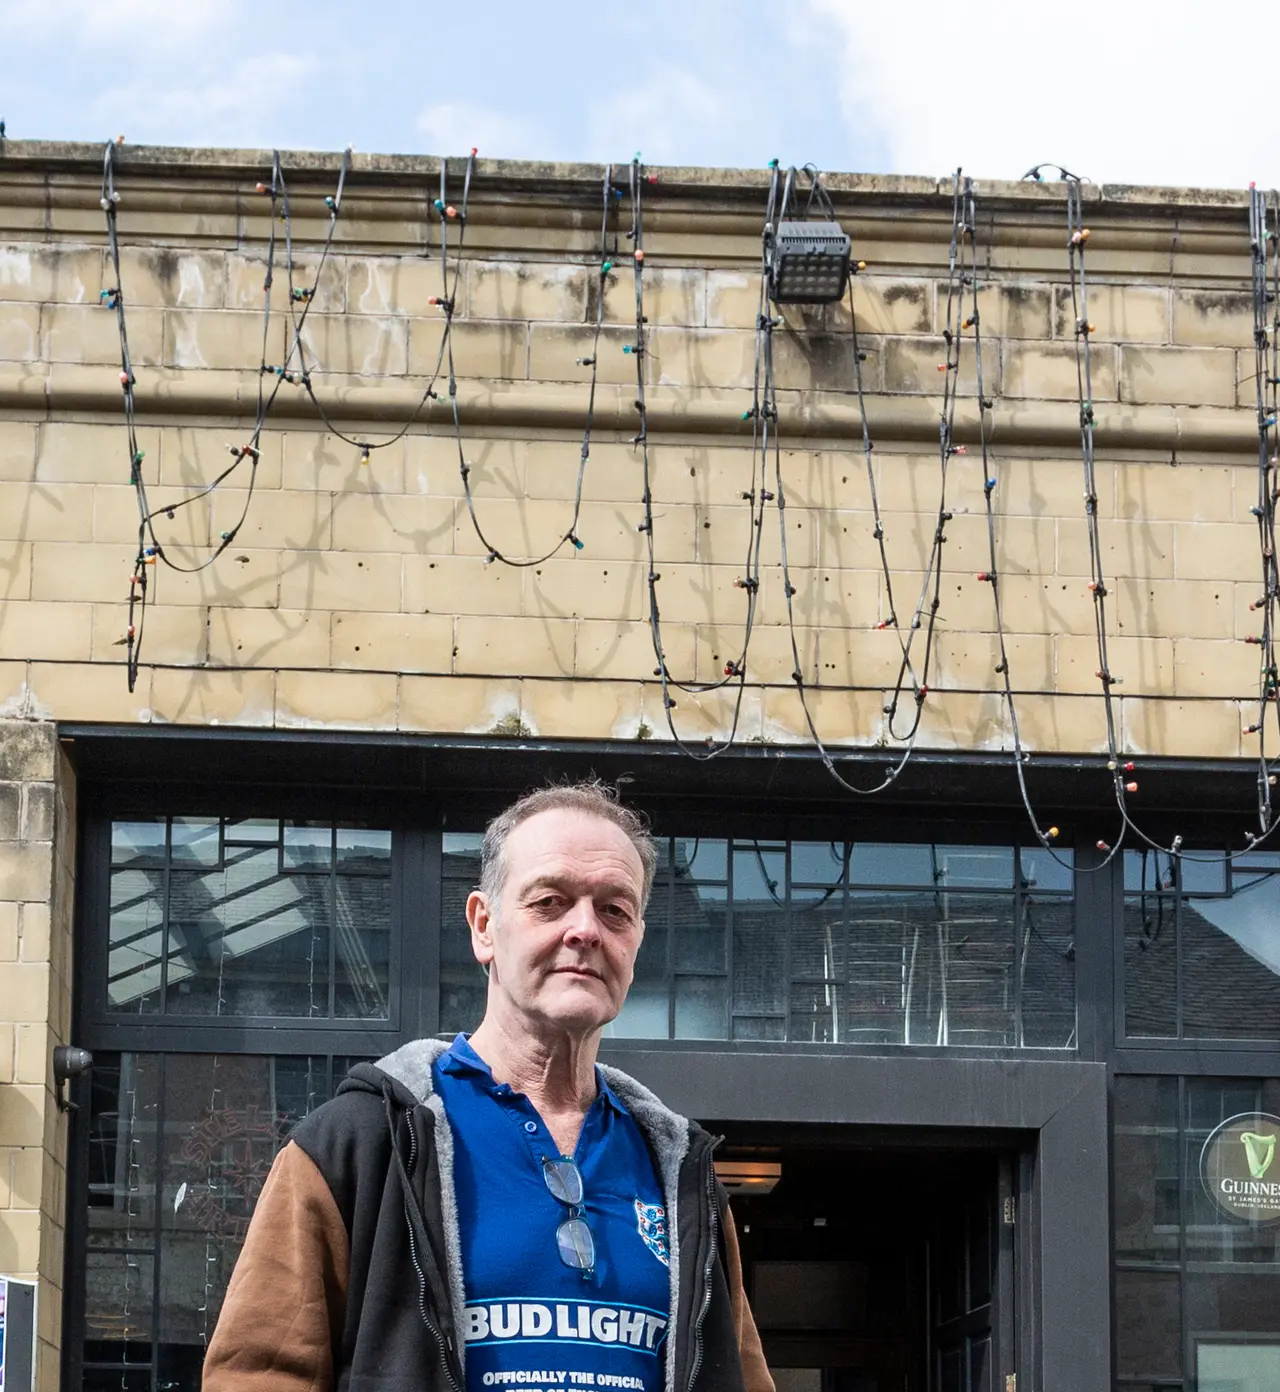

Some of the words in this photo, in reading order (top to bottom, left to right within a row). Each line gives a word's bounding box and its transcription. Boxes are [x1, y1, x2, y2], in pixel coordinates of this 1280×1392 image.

[464, 1303, 552, 1341] BUD
[556, 1304, 667, 1349] LIGHT
[482, 1370, 567, 1386] OFFICIALLY
[569, 1371, 595, 1384] THE
[596, 1374, 645, 1391] OFFICIAL
